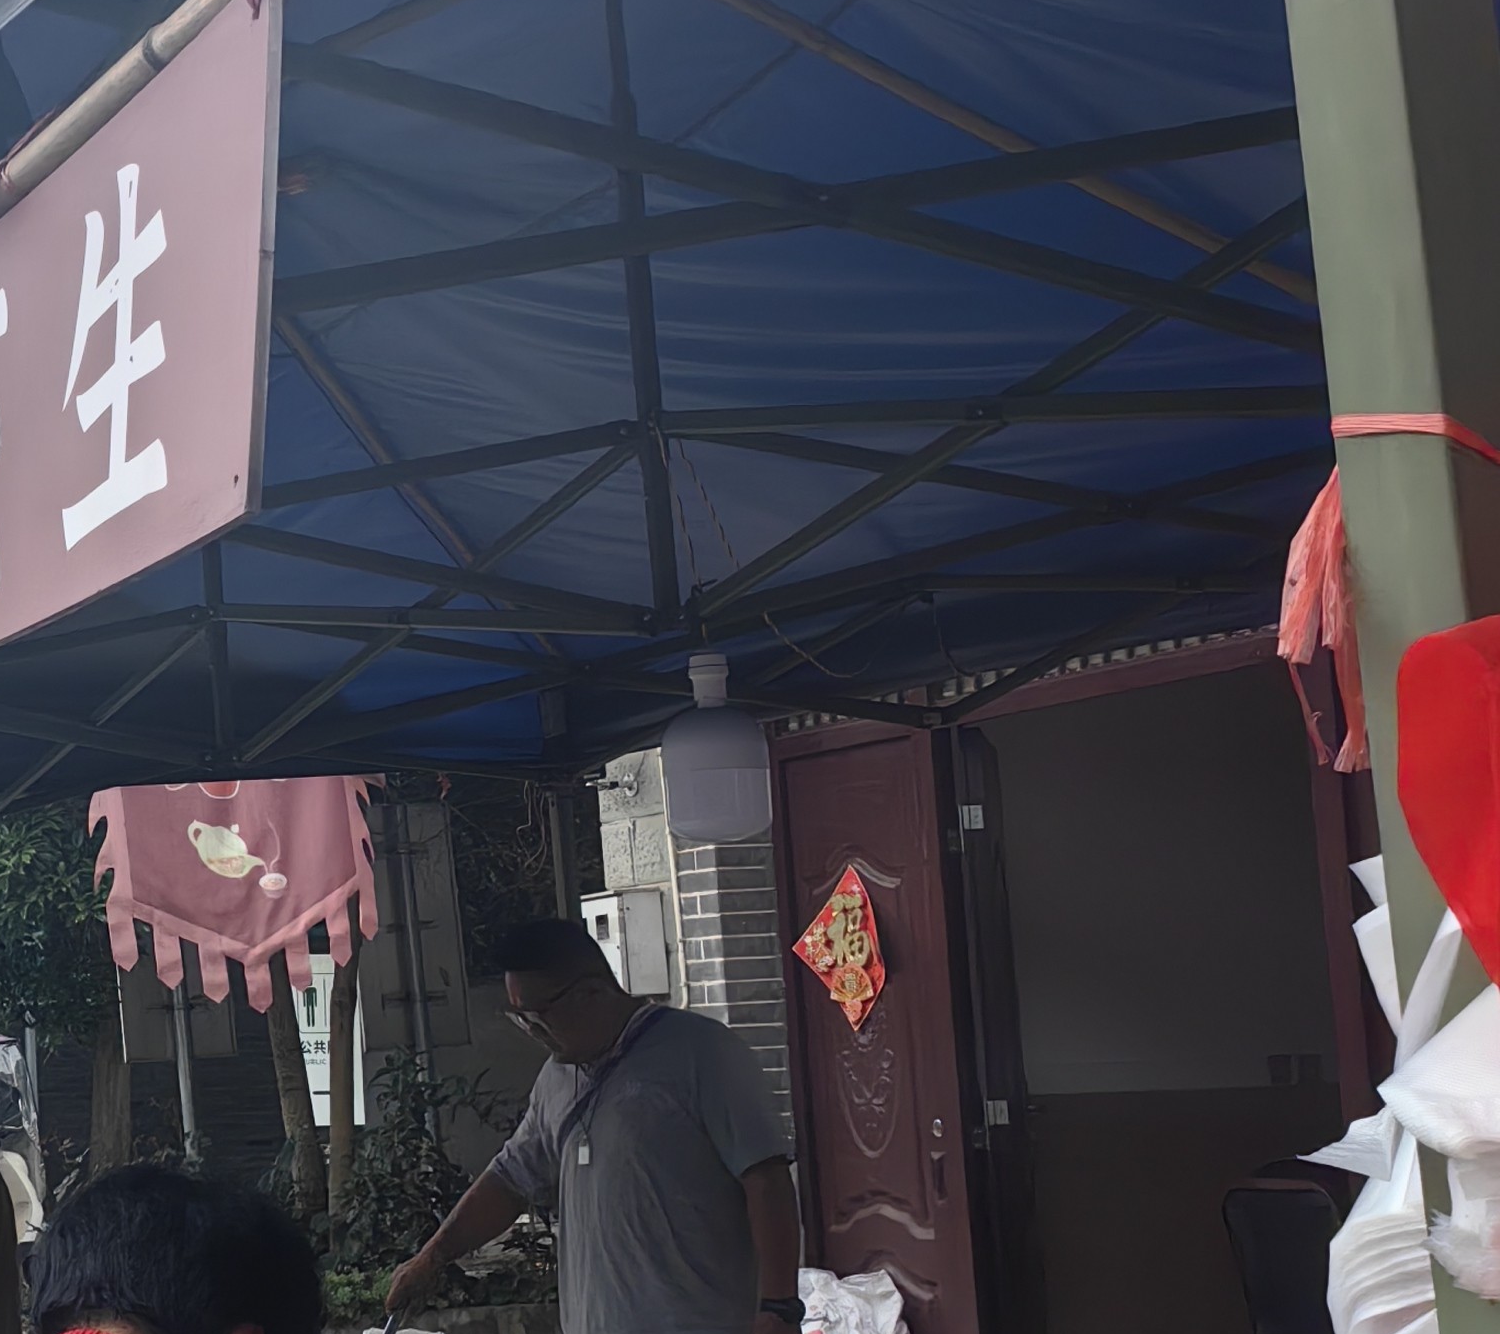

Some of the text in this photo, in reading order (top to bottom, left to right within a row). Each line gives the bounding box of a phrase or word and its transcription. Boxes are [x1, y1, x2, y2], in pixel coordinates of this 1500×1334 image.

[826, 892, 871, 967] 福
[300, 1040, 331, 1054] 公共
[304, 1058, 328, 1066] UBLIC
